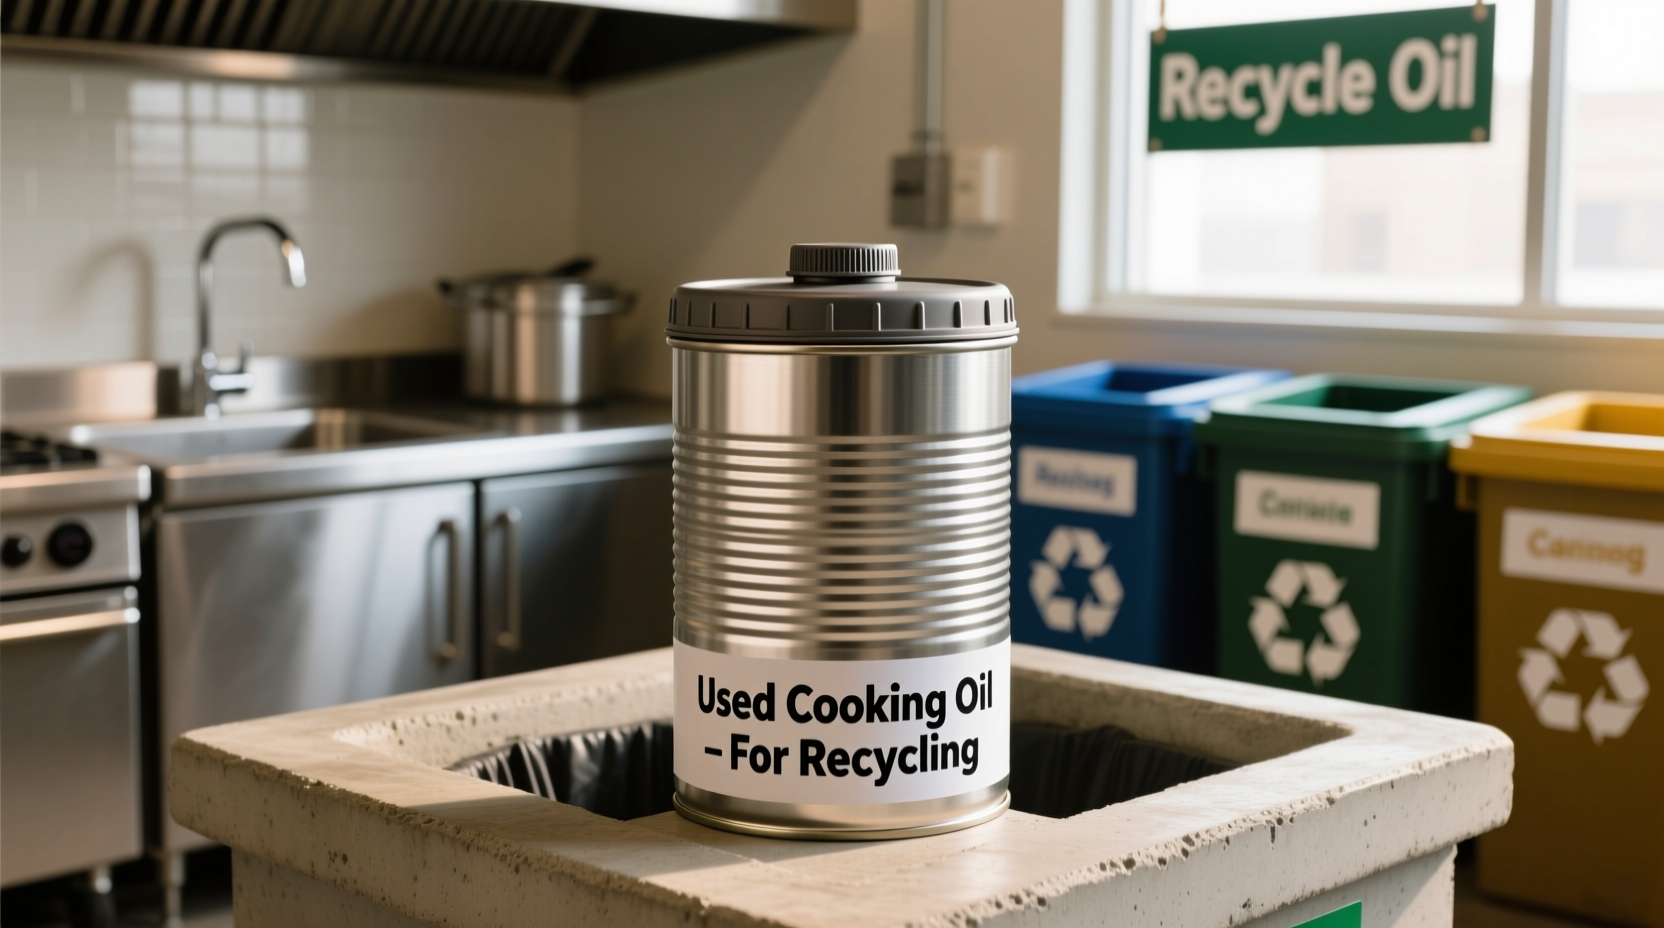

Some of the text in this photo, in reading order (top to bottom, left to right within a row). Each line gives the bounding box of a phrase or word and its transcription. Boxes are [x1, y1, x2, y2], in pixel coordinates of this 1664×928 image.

[1158, 32, 1478, 136] Recycle Oil
[697, 669, 993, 730] Used Cooking Oil
[730, 733, 790, 775] For
[799, 732, 979, 787] Recycling
